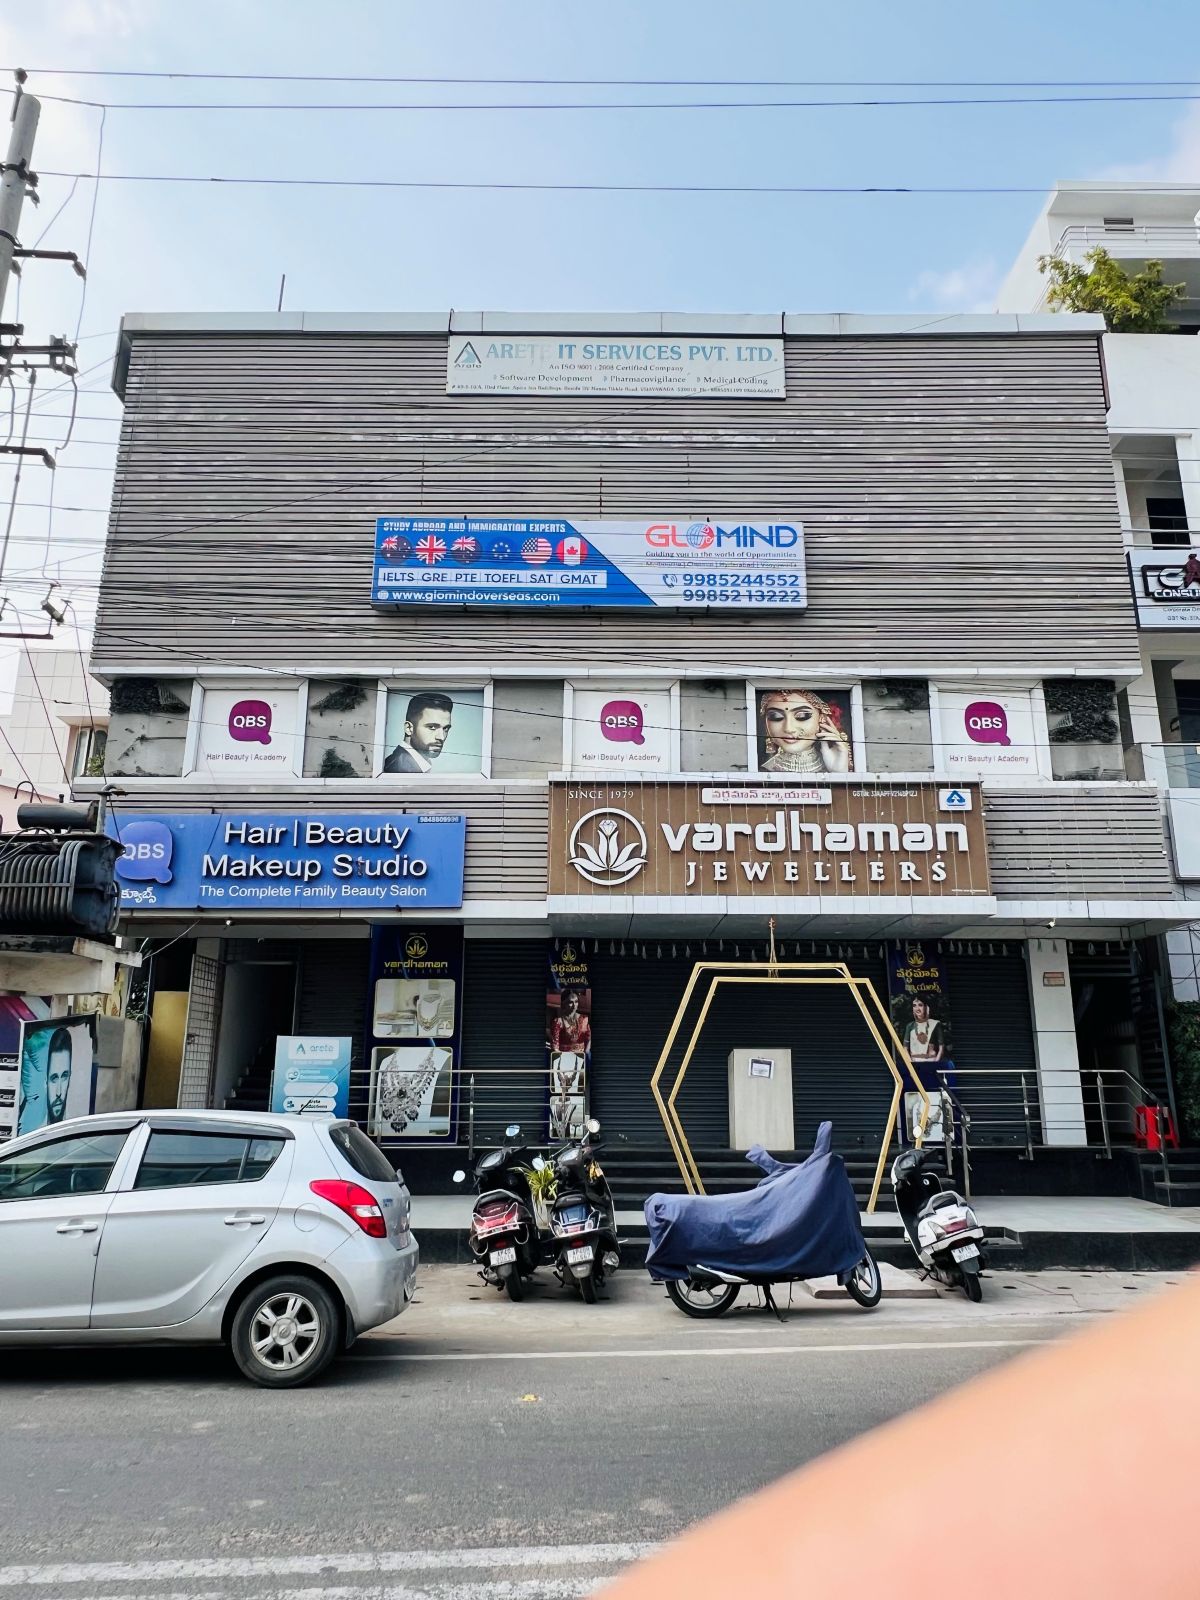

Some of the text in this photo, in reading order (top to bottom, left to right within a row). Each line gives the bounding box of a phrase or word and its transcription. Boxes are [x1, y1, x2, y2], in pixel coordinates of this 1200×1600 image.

[558, 344, 577, 360] IT
[582, 344, 682, 361] SERVICES
[688, 345, 729, 361] PVT.
[736, 346, 778, 362] LTD.
[649, 365, 684, 374] Company
[538, 374, 593, 383] Development
[610, 375, 686, 384] Pharmacovigilance
[703, 376, 768, 385] Medical Coding
[383, 521, 566, 533] STUDY ABROAD AND IMMIGRATION EXPERTS
[645, 523, 798, 549] GLOMIND
[746, 551, 797, 559] Opportunities
[383, 572, 598, 585] IELTS GRE PTE TOEFL SAT GMAT
[682, 573, 800, 587] 9985244552
[1154, 588, 1200, 597] CONSU
[233, 715, 267, 728] QBS
[605, 715, 638, 729] QBS
[969, 716, 1003, 730] QBS
[225, 753, 249, 762] Beauty
[254, 753, 287, 762] Academy
[600, 754, 625, 762] Beauty
[629, 754, 661, 762] Academy
[968, 755, 992, 763] Beauty
[997, 755, 1029, 764] Academy
[568, 790, 634, 799] SINCE 1979
[224, 821, 410, 849] Hair Beauty
[660, 810, 969, 852] vardhaman
[122, 843, 165, 860] QBS
[202, 853, 428, 882] Makeup Studio
[686, 861, 947, 887] JEWELLERS
[200, 885, 427, 899] The Complete Family Beauty Salon
[384, 960, 449, 968] vardhaman
